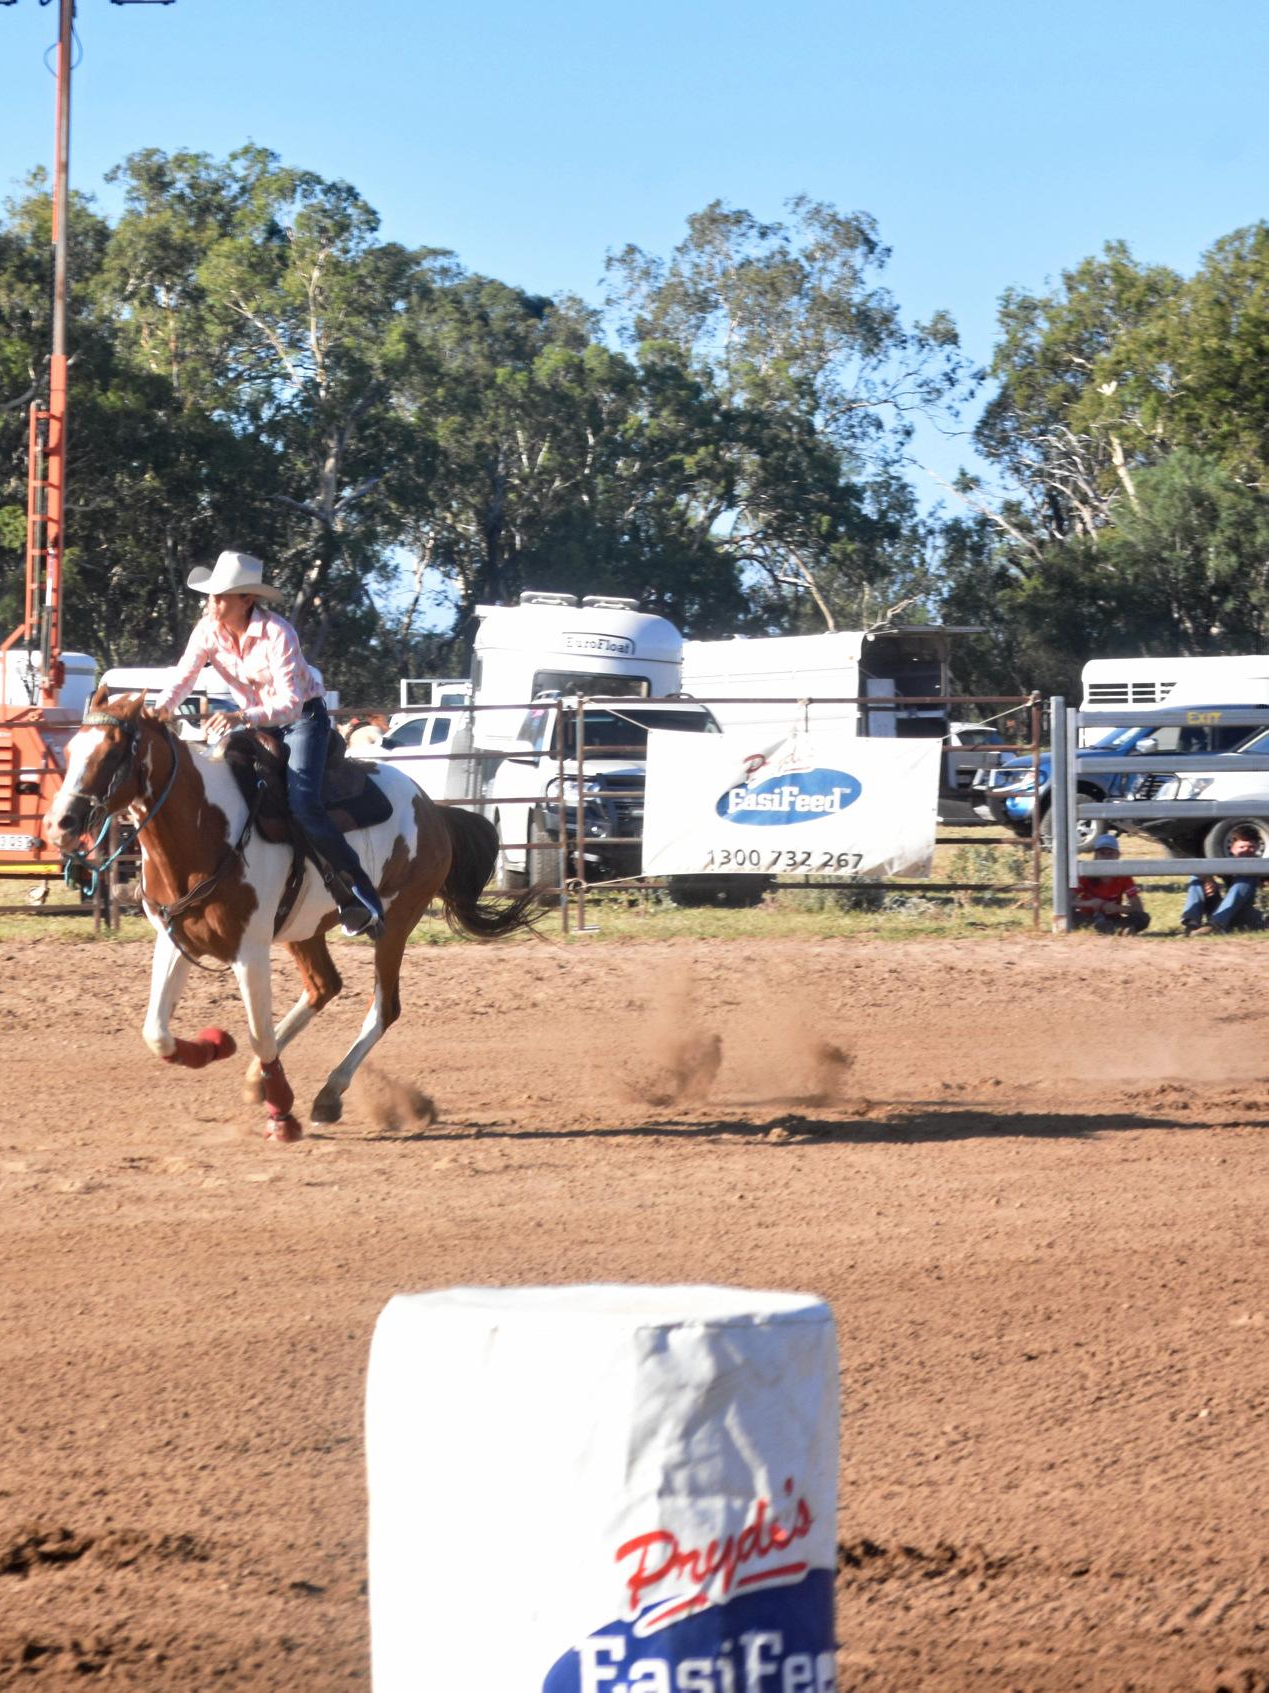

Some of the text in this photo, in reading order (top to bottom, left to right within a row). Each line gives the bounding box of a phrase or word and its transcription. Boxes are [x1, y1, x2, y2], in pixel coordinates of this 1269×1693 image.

[566, 636, 630, 654] EuroFloat
[1186, 711, 1223, 725] EXIT
[728, 786, 842, 814] EasiFeed
[707, 849, 864, 869] 1300 732 267
[615, 1476, 814, 1612] Pryde's
